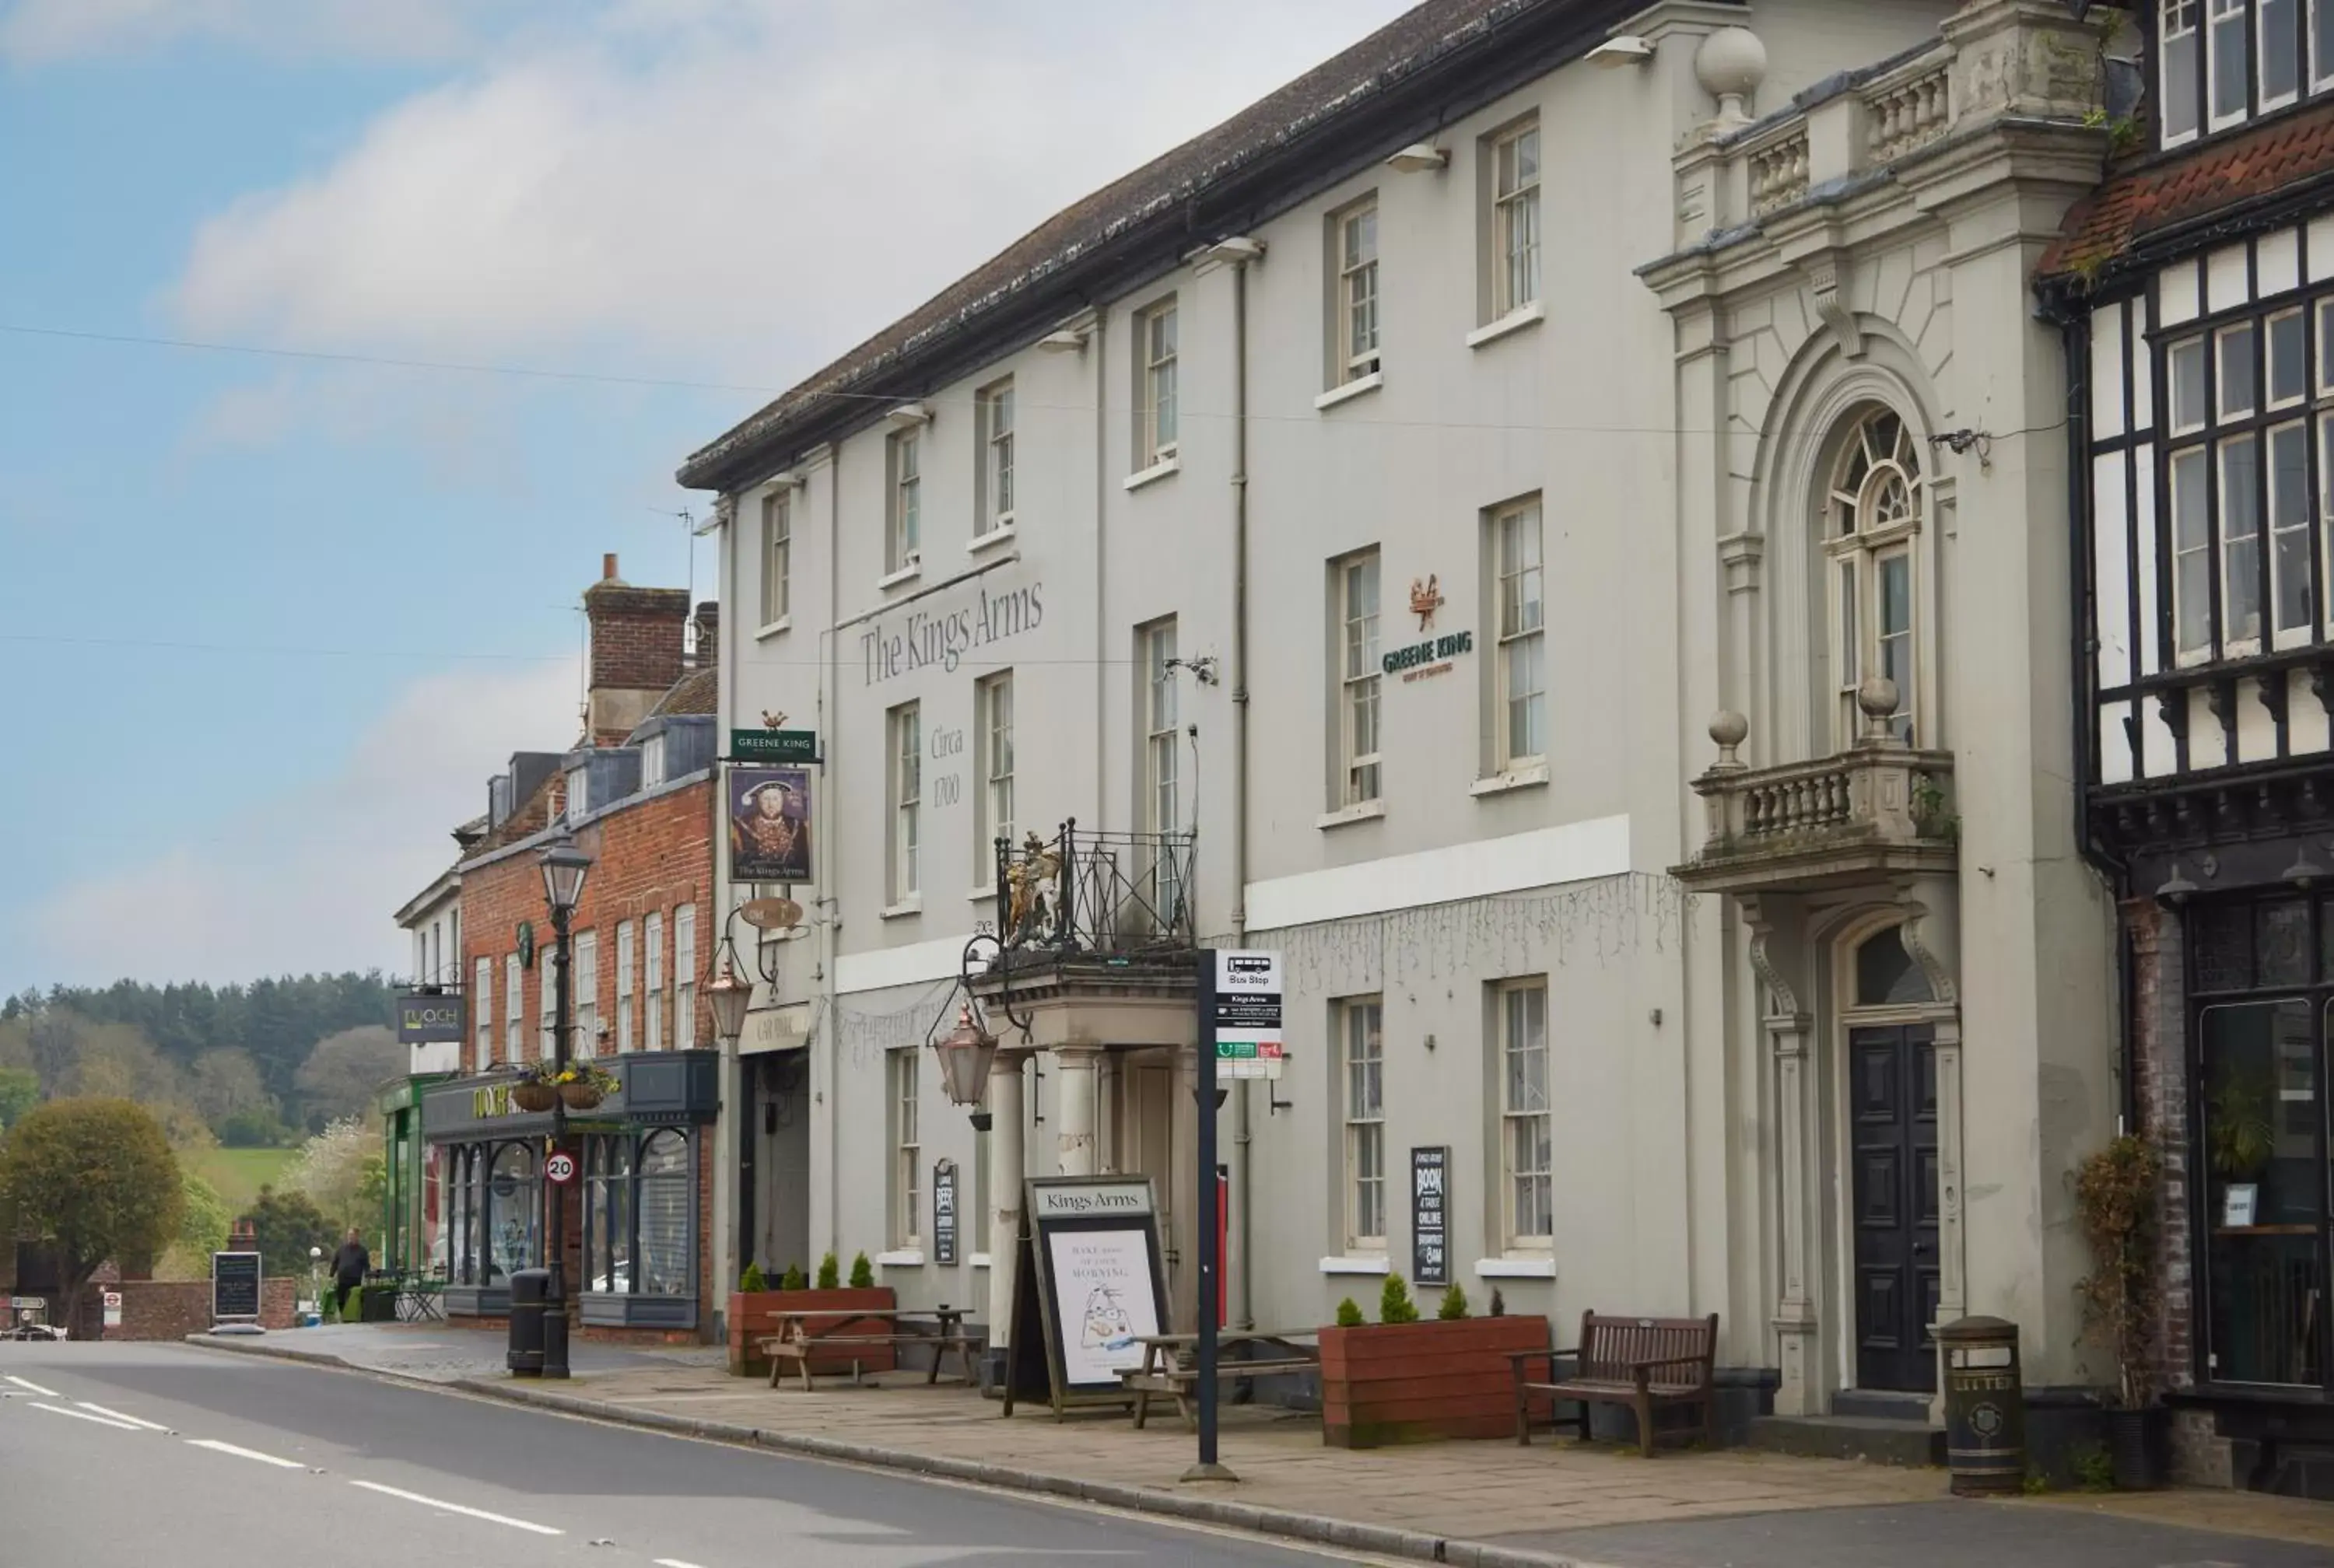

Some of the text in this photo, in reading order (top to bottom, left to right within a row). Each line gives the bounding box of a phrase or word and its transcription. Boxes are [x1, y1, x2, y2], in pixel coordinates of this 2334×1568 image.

[860, 582, 1043, 687] The Kings Arms
[1383, 640, 1434, 674] GREENE
[1437, 631, 1472, 658] KING
[738, 737, 810, 749] GREENE KING
[931, 723, 963, 760] Circa
[934, 772, 960, 809] 1700
[1229, 975, 1269, 986] Bus Stop
[549, 1161, 571, 1175] 20
[1417, 1168, 1442, 1197] BOOK
[1047, 1192, 1138, 1210] Kings Arms
[1954, 1375, 2014, 1391] LITTER
